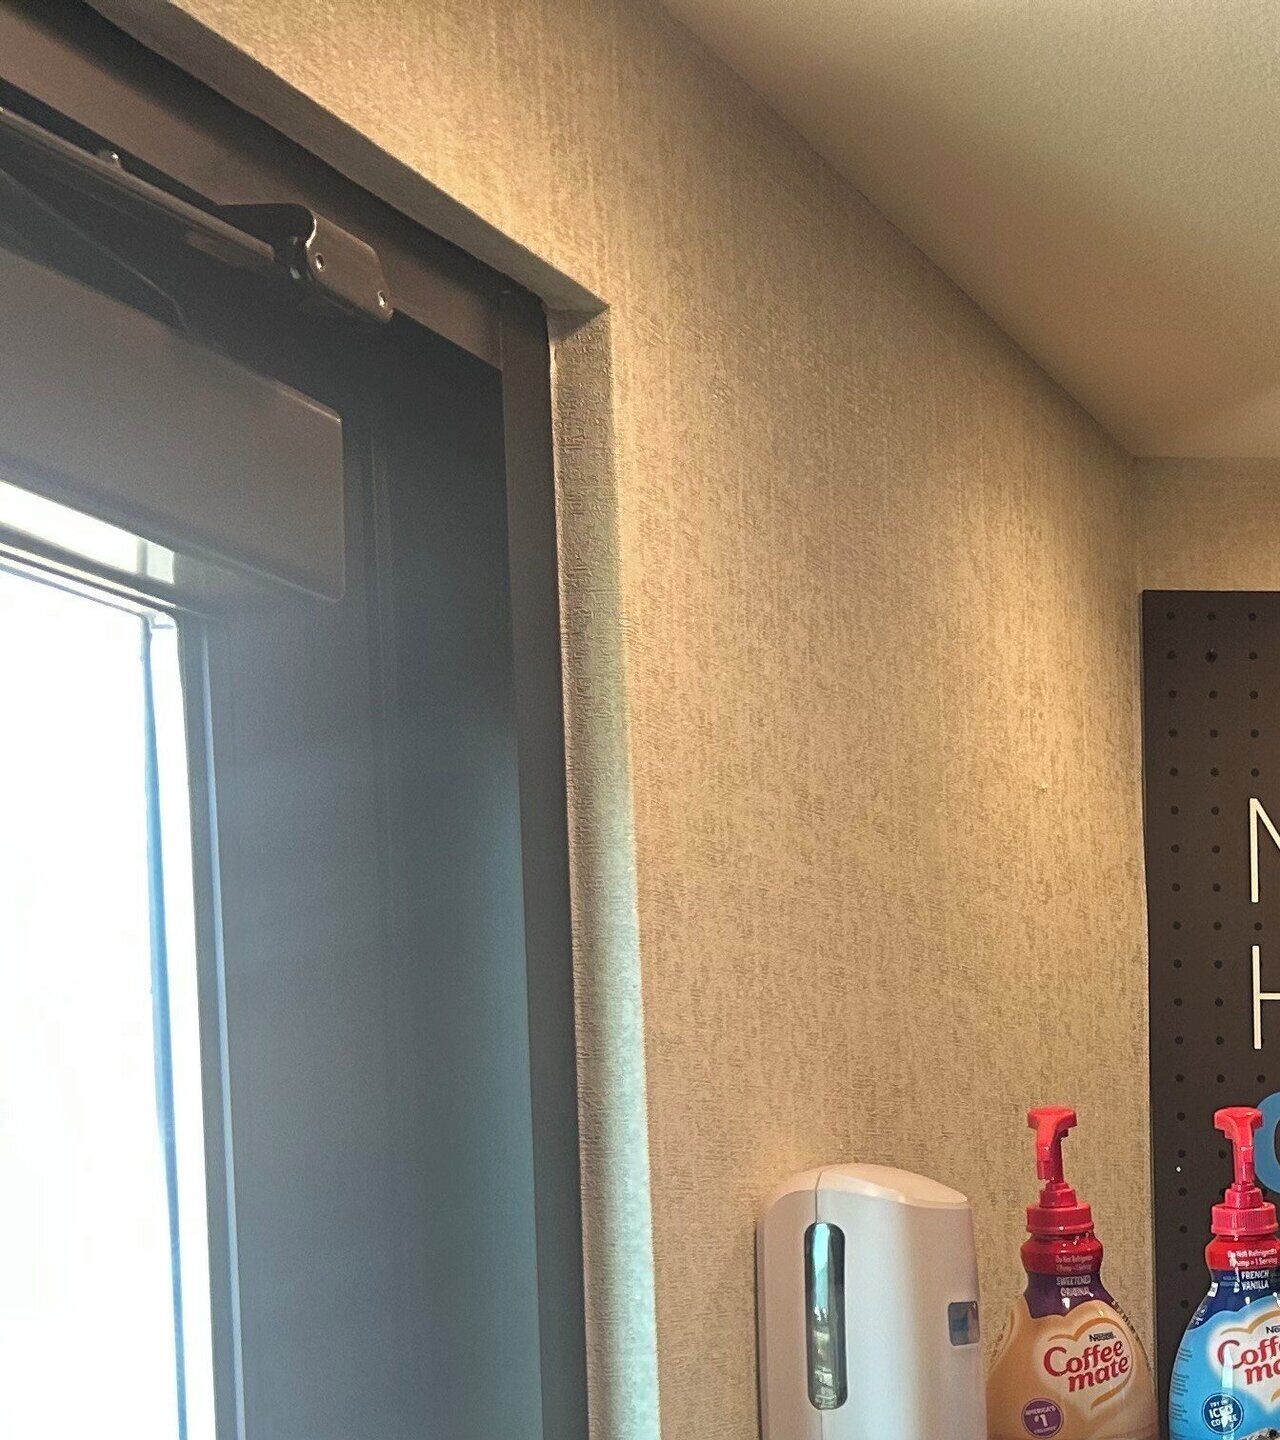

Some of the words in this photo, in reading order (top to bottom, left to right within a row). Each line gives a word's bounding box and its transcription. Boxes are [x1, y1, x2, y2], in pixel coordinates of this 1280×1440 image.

[1241, 1270, 1270, 1280] FRENCH
[1241, 1280, 1270, 1291] VANILLA
[1043, 1340, 1125, 1377] Coffee
[1068, 1356, 1130, 1392] mate
